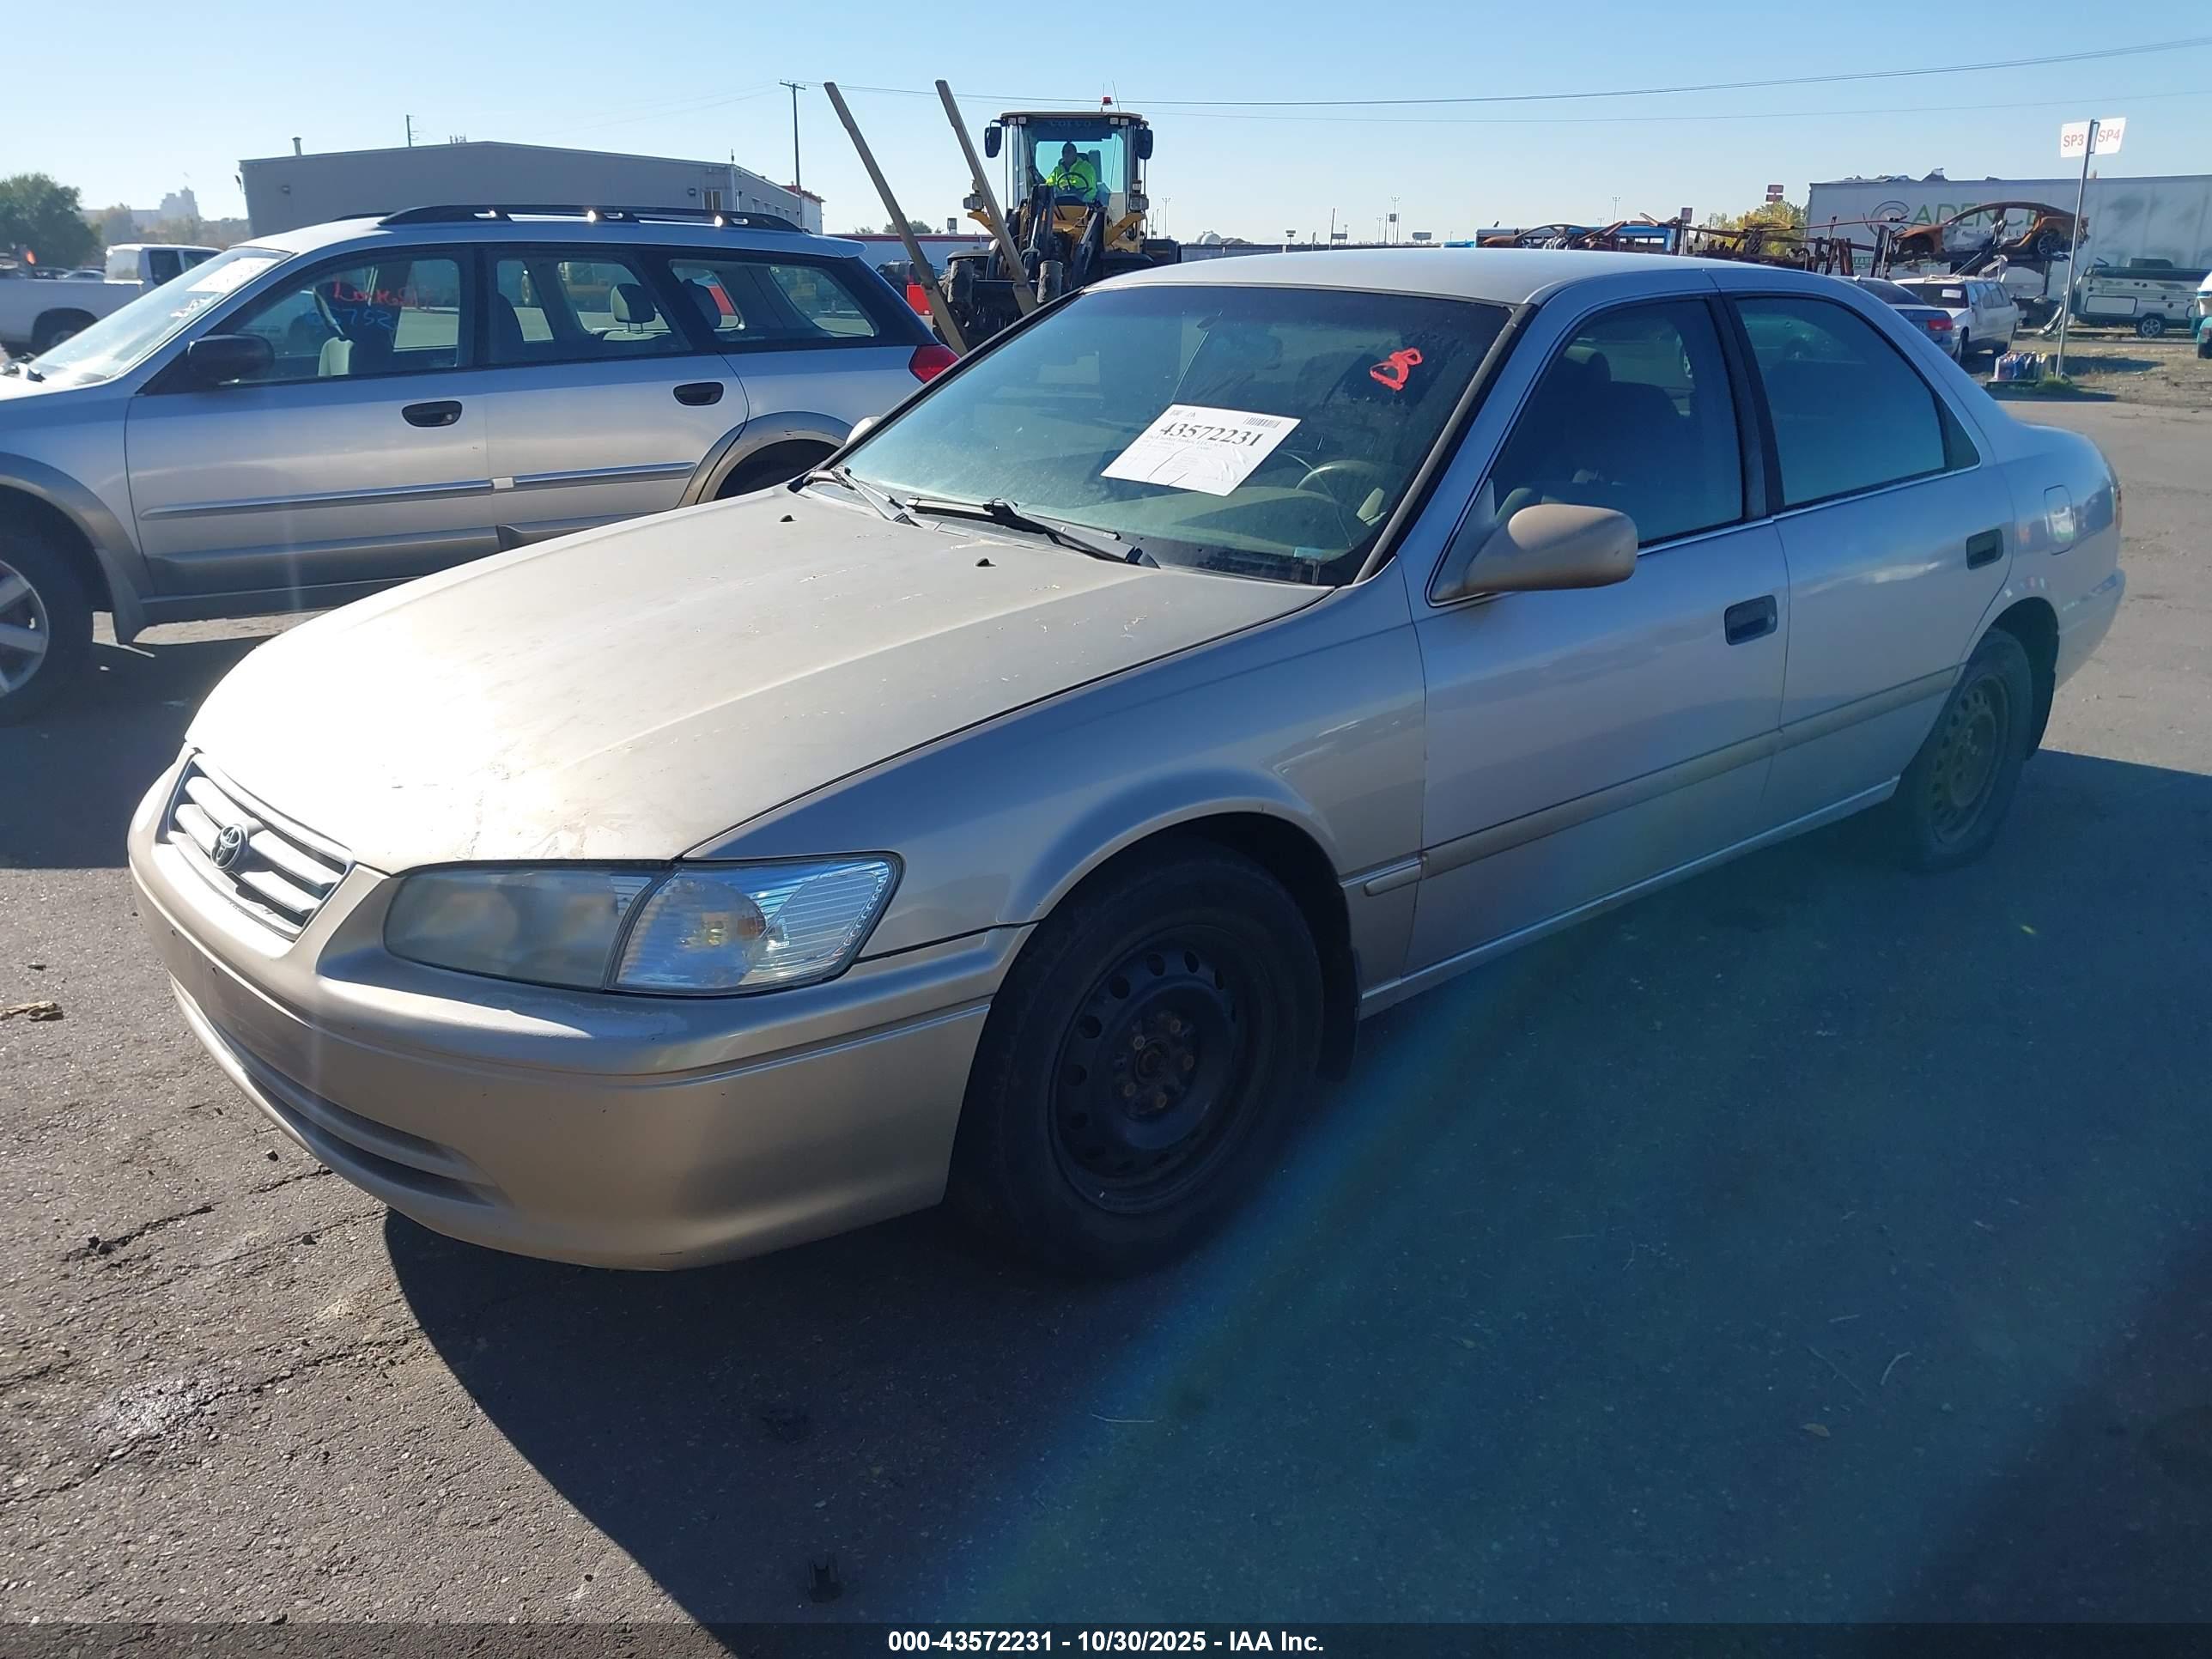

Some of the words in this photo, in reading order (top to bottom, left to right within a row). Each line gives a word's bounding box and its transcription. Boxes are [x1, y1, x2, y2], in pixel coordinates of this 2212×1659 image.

[2063, 133, 2084, 148] SP3
[2098, 129, 2120, 143] SP4
[1160, 422, 1264, 447] 43572231
